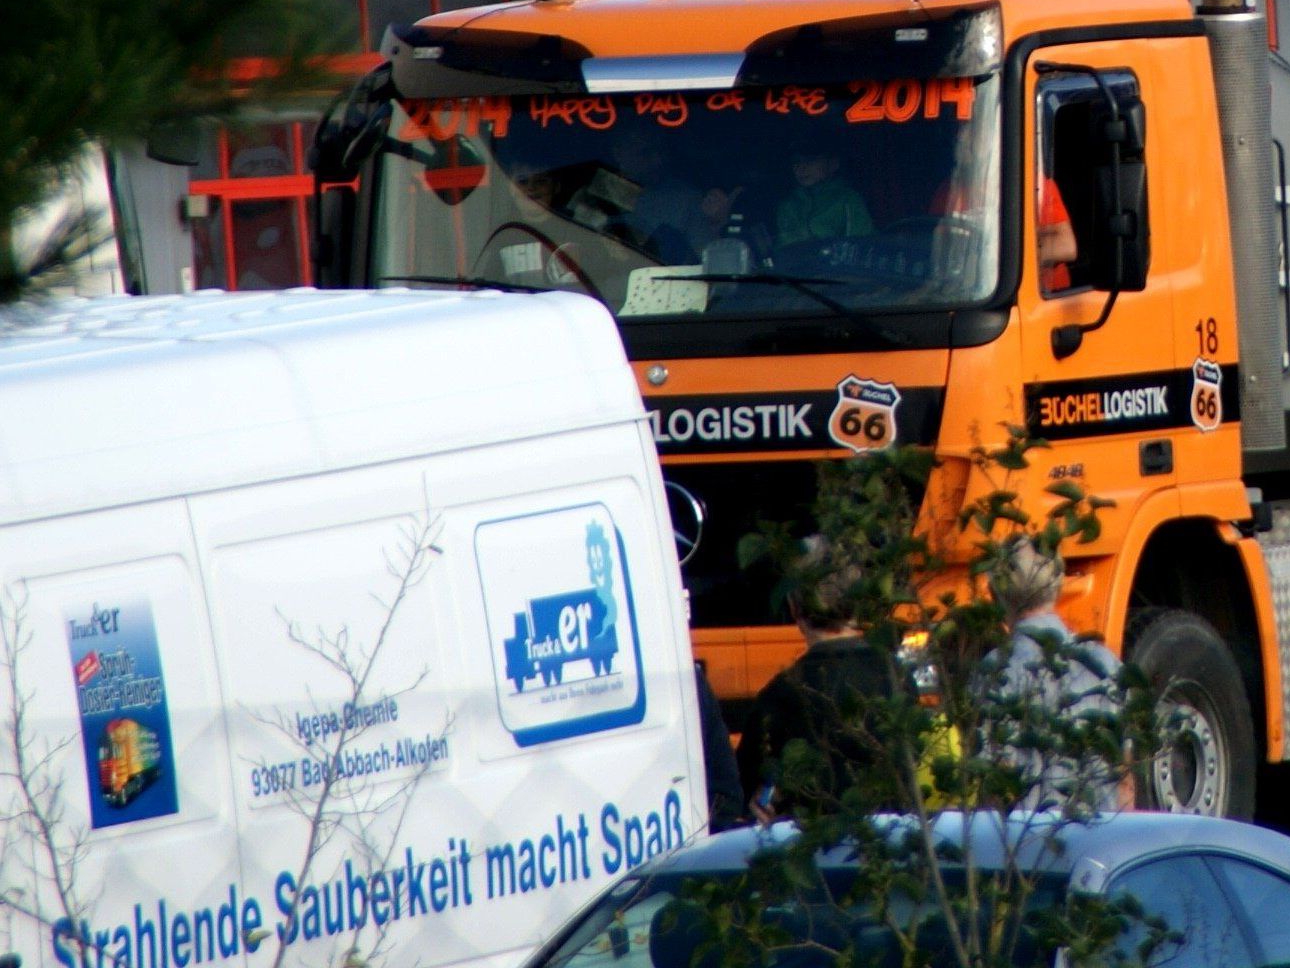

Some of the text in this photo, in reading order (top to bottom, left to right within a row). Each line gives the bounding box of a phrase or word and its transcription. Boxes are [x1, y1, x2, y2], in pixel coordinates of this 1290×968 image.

[844, 78, 977, 123] 2014
[1196, 317, 1219, 355] 18
[652, 402, 814, 444] LOGISTIK
[840, 407, 887, 442] 66
[1196, 387, 1217, 421] 66
[251, 760, 297, 797] 93077
[302, 751, 333, 788] Bad
[274, 836, 473, 946] Sauberkeit
[485, 813, 591, 900] macht
[600, 788, 684, 875] Spaß
